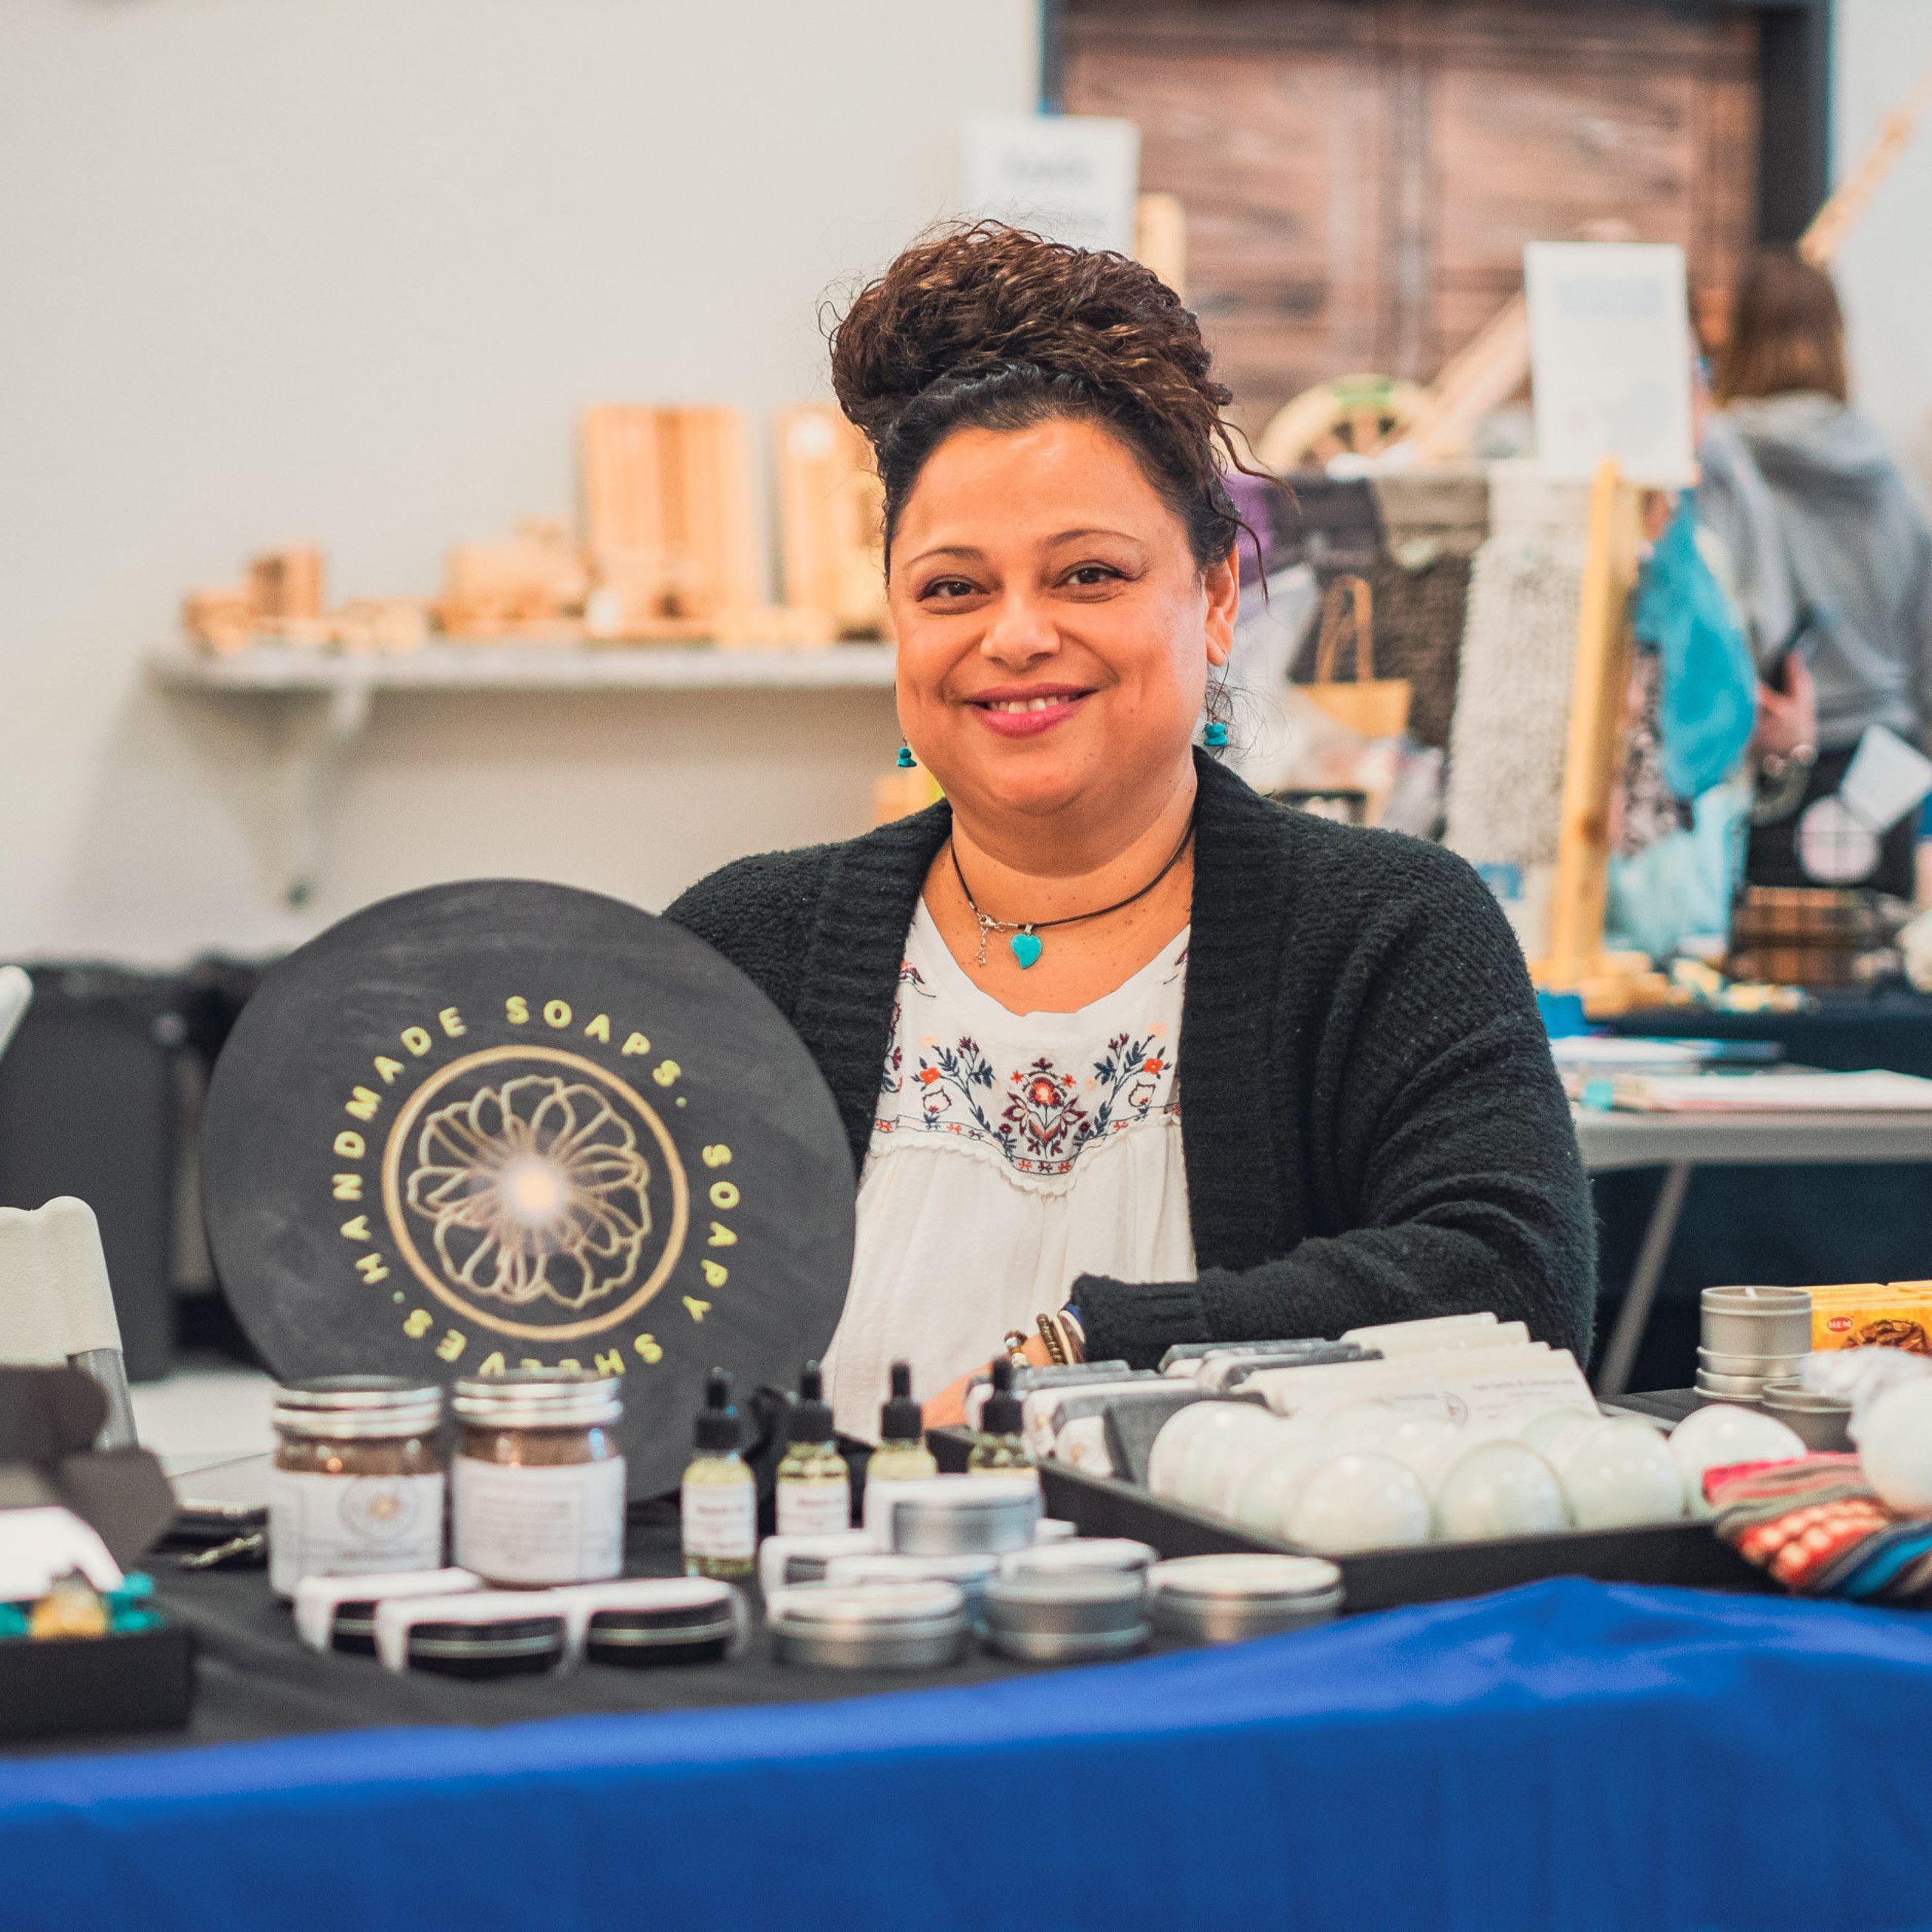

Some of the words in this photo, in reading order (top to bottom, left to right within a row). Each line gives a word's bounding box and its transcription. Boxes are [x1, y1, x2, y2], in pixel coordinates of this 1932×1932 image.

[332, 1006, 466, 1284] HANDMADE
[683, 1143, 740, 1322] SOAPY
[1829, 1320, 1852, 1328] HEM
